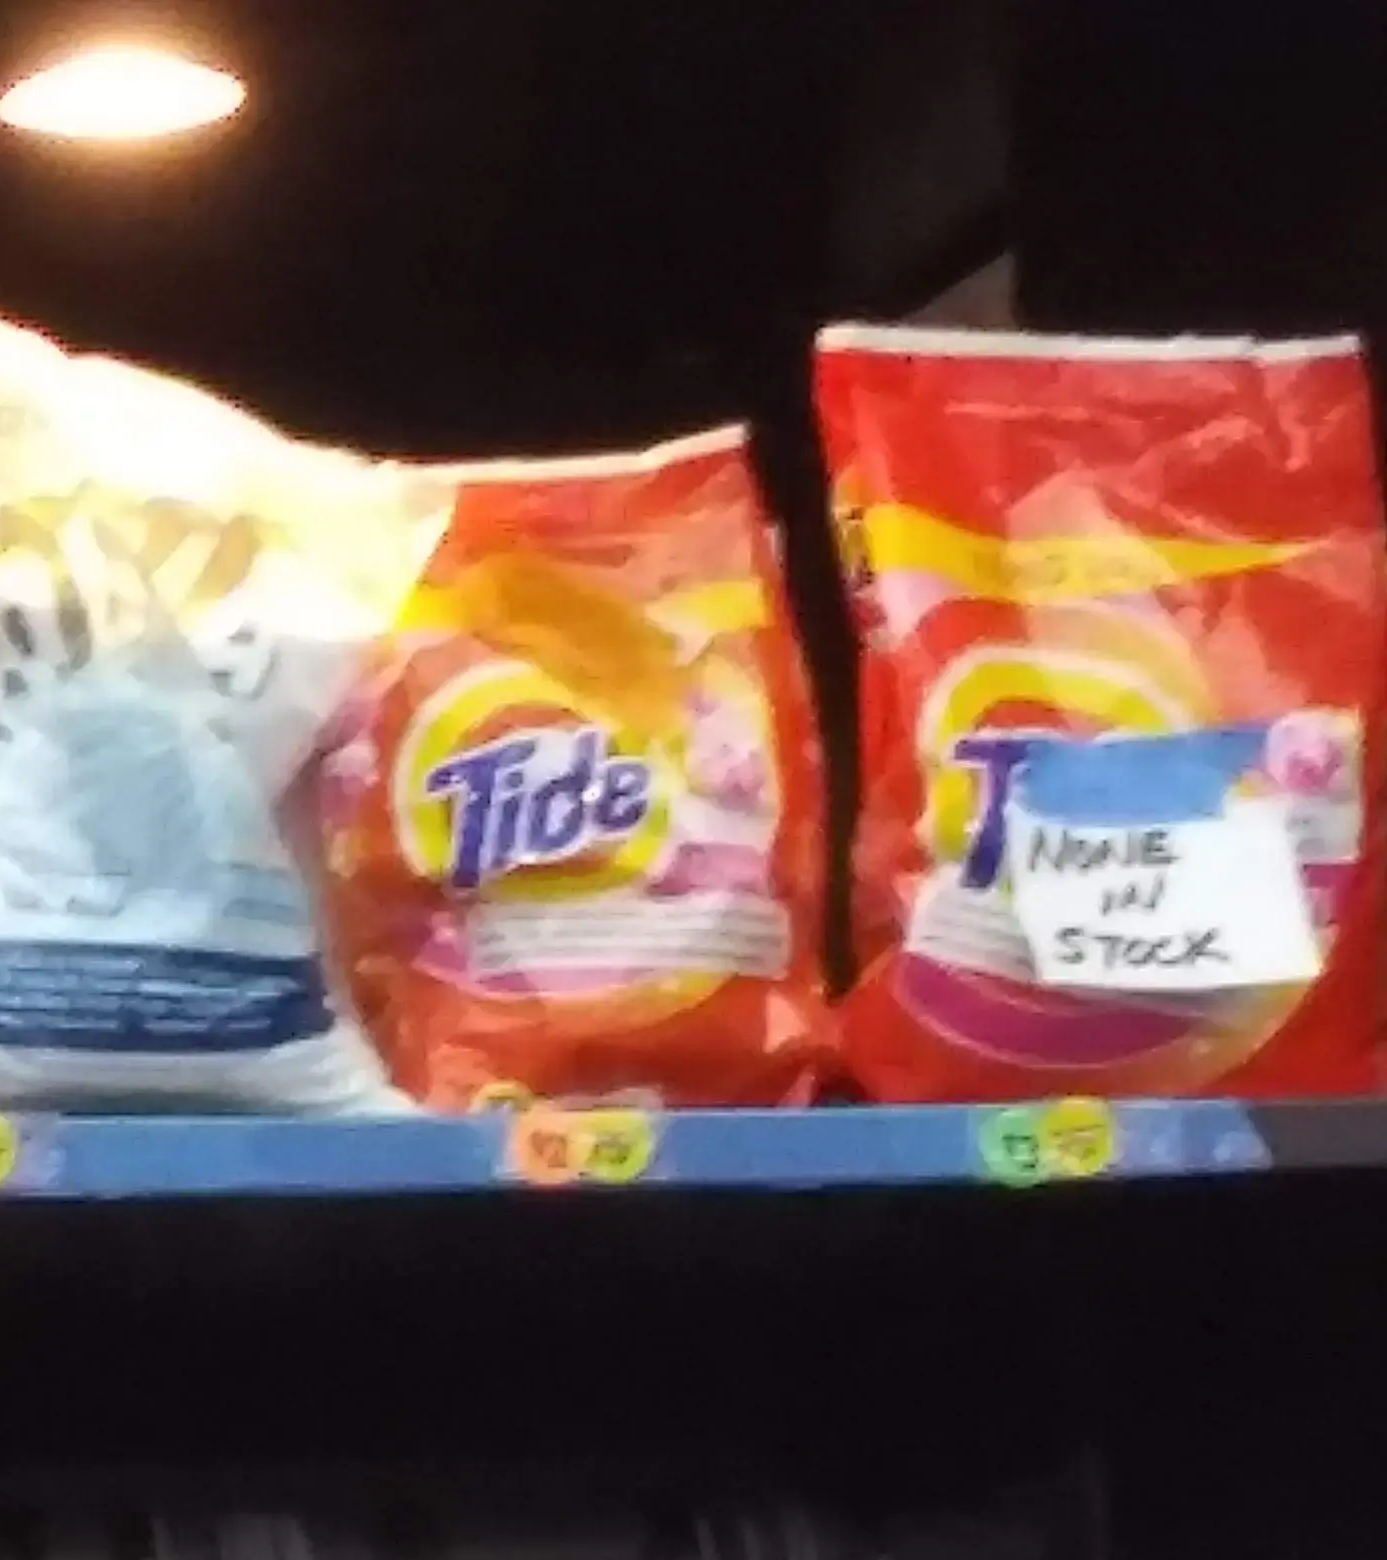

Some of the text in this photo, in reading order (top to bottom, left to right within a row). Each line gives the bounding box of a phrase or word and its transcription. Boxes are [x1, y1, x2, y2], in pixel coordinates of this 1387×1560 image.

[428, 728, 651, 889] Tide
[1028, 827, 1180, 874] NONE
[1056, 927, 1231, 970] STOCK
